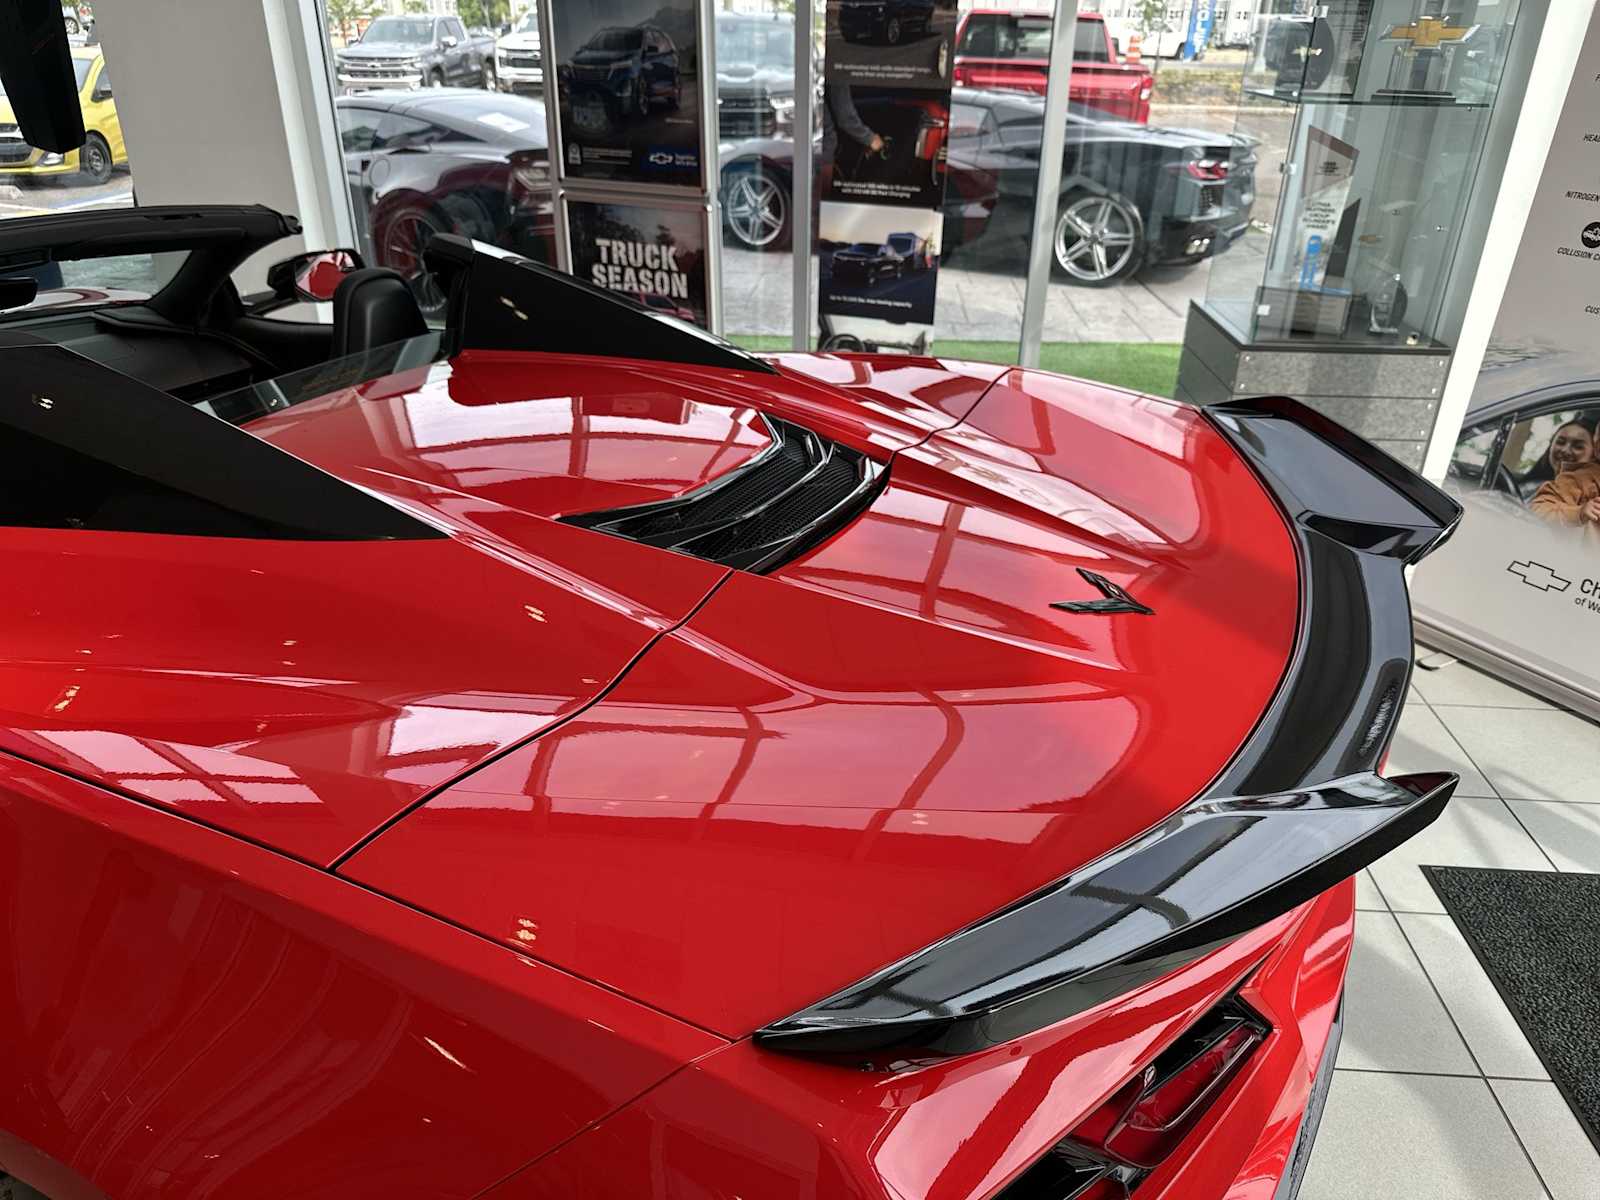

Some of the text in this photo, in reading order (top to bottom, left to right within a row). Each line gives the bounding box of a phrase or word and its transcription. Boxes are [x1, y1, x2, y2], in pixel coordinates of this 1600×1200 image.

[1565, 190, 1599, 203] NITROGEN
[595, 238, 679, 272] TRUCK
[1557, 247, 1594, 259] COLLISION
[592, 263, 688, 299] SEASON
[1575, 597, 1587, 606] of
